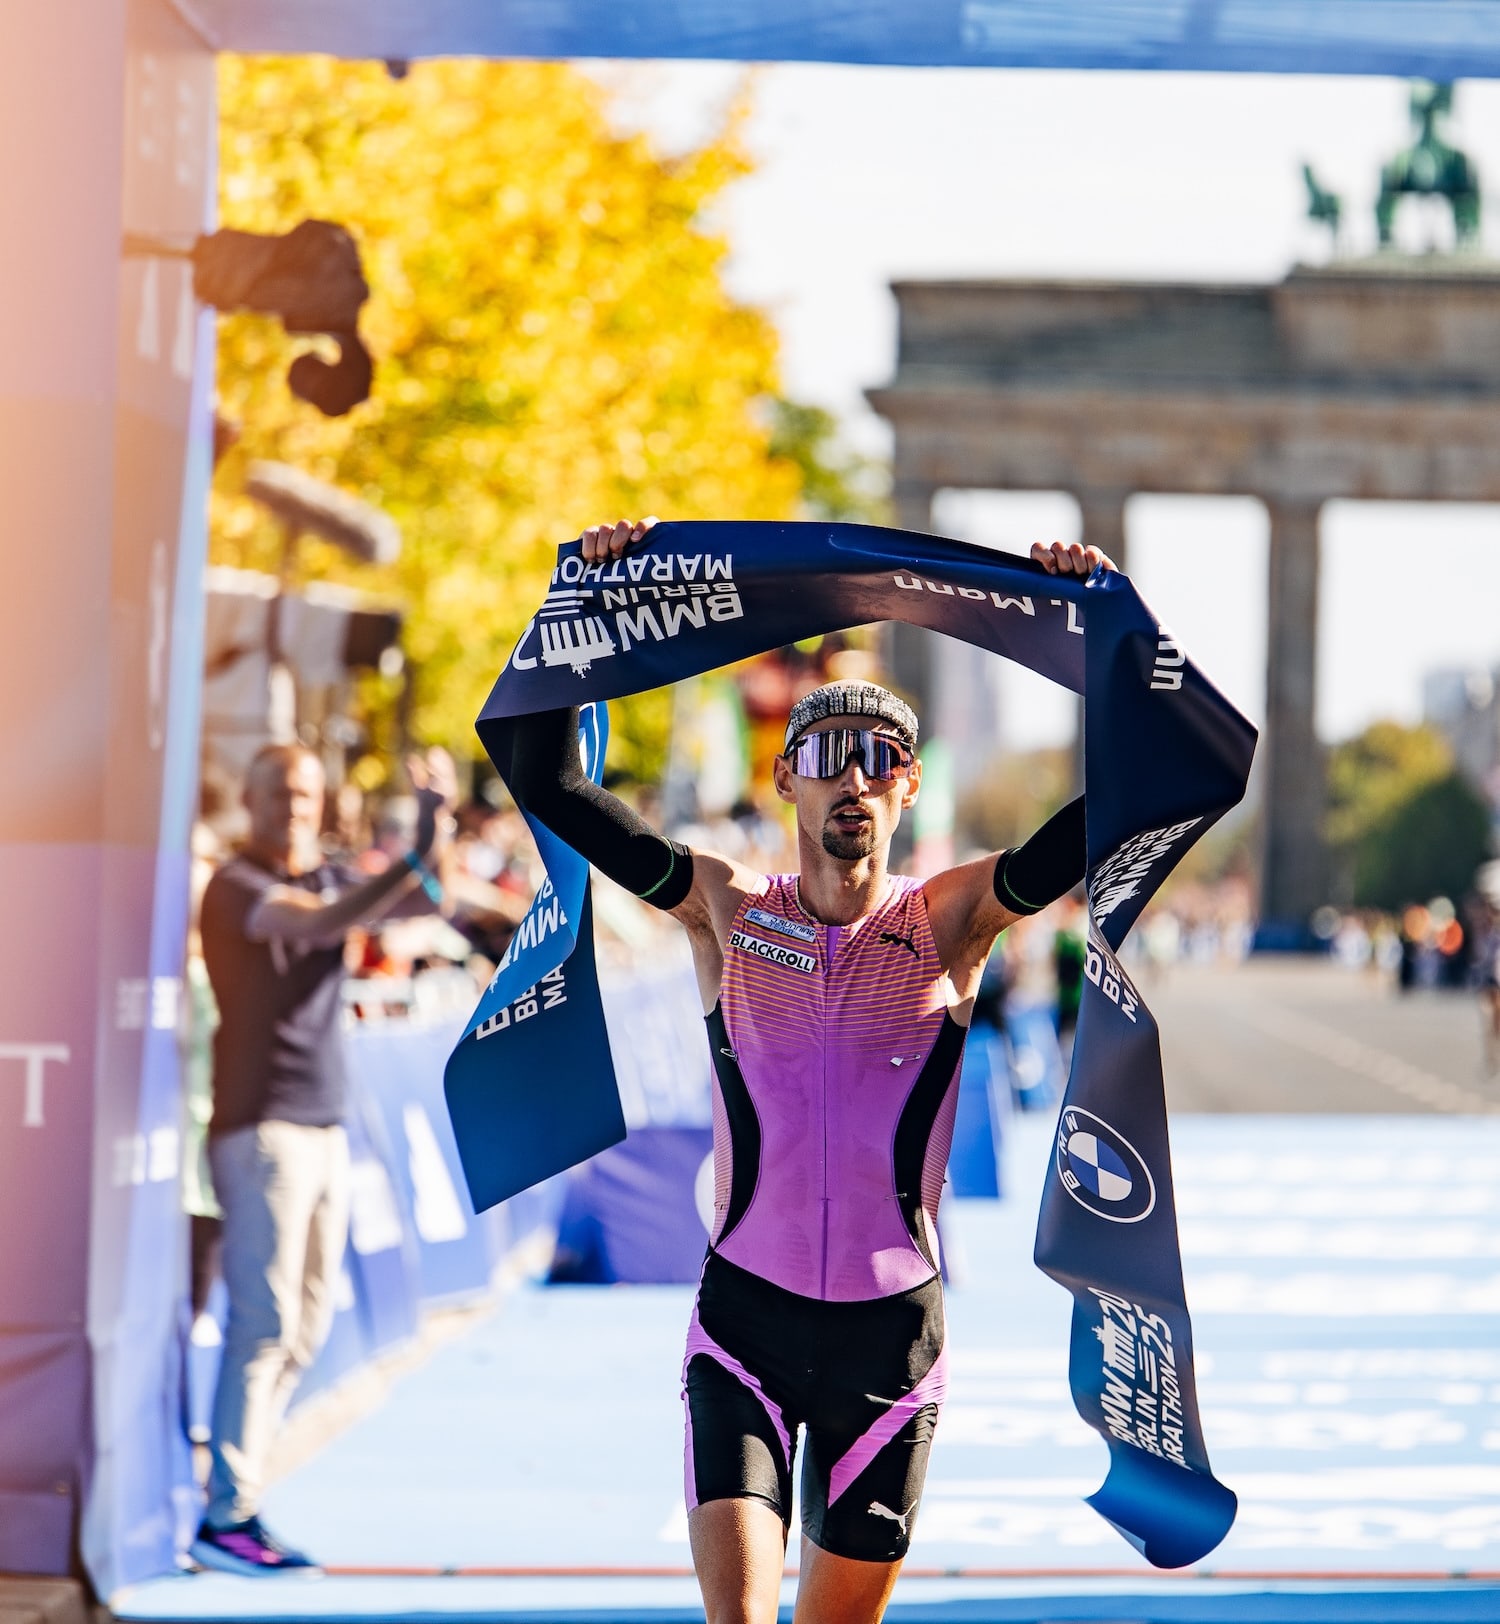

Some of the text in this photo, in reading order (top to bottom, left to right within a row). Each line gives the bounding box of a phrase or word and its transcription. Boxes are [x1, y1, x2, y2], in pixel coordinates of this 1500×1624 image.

[602, 583, 738, 610] BERLIN
[893, 576, 1036, 616] Mann
[512, 592, 744, 671] BMW 2
[1119, 816, 1204, 881] BMW
[513, 896, 569, 963] MW
[730, 933, 811, 972] BLACKROLL
[1088, 1287, 1144, 1449] BMW 20
[1133, 1304, 1192, 1470] ARATHON 25
